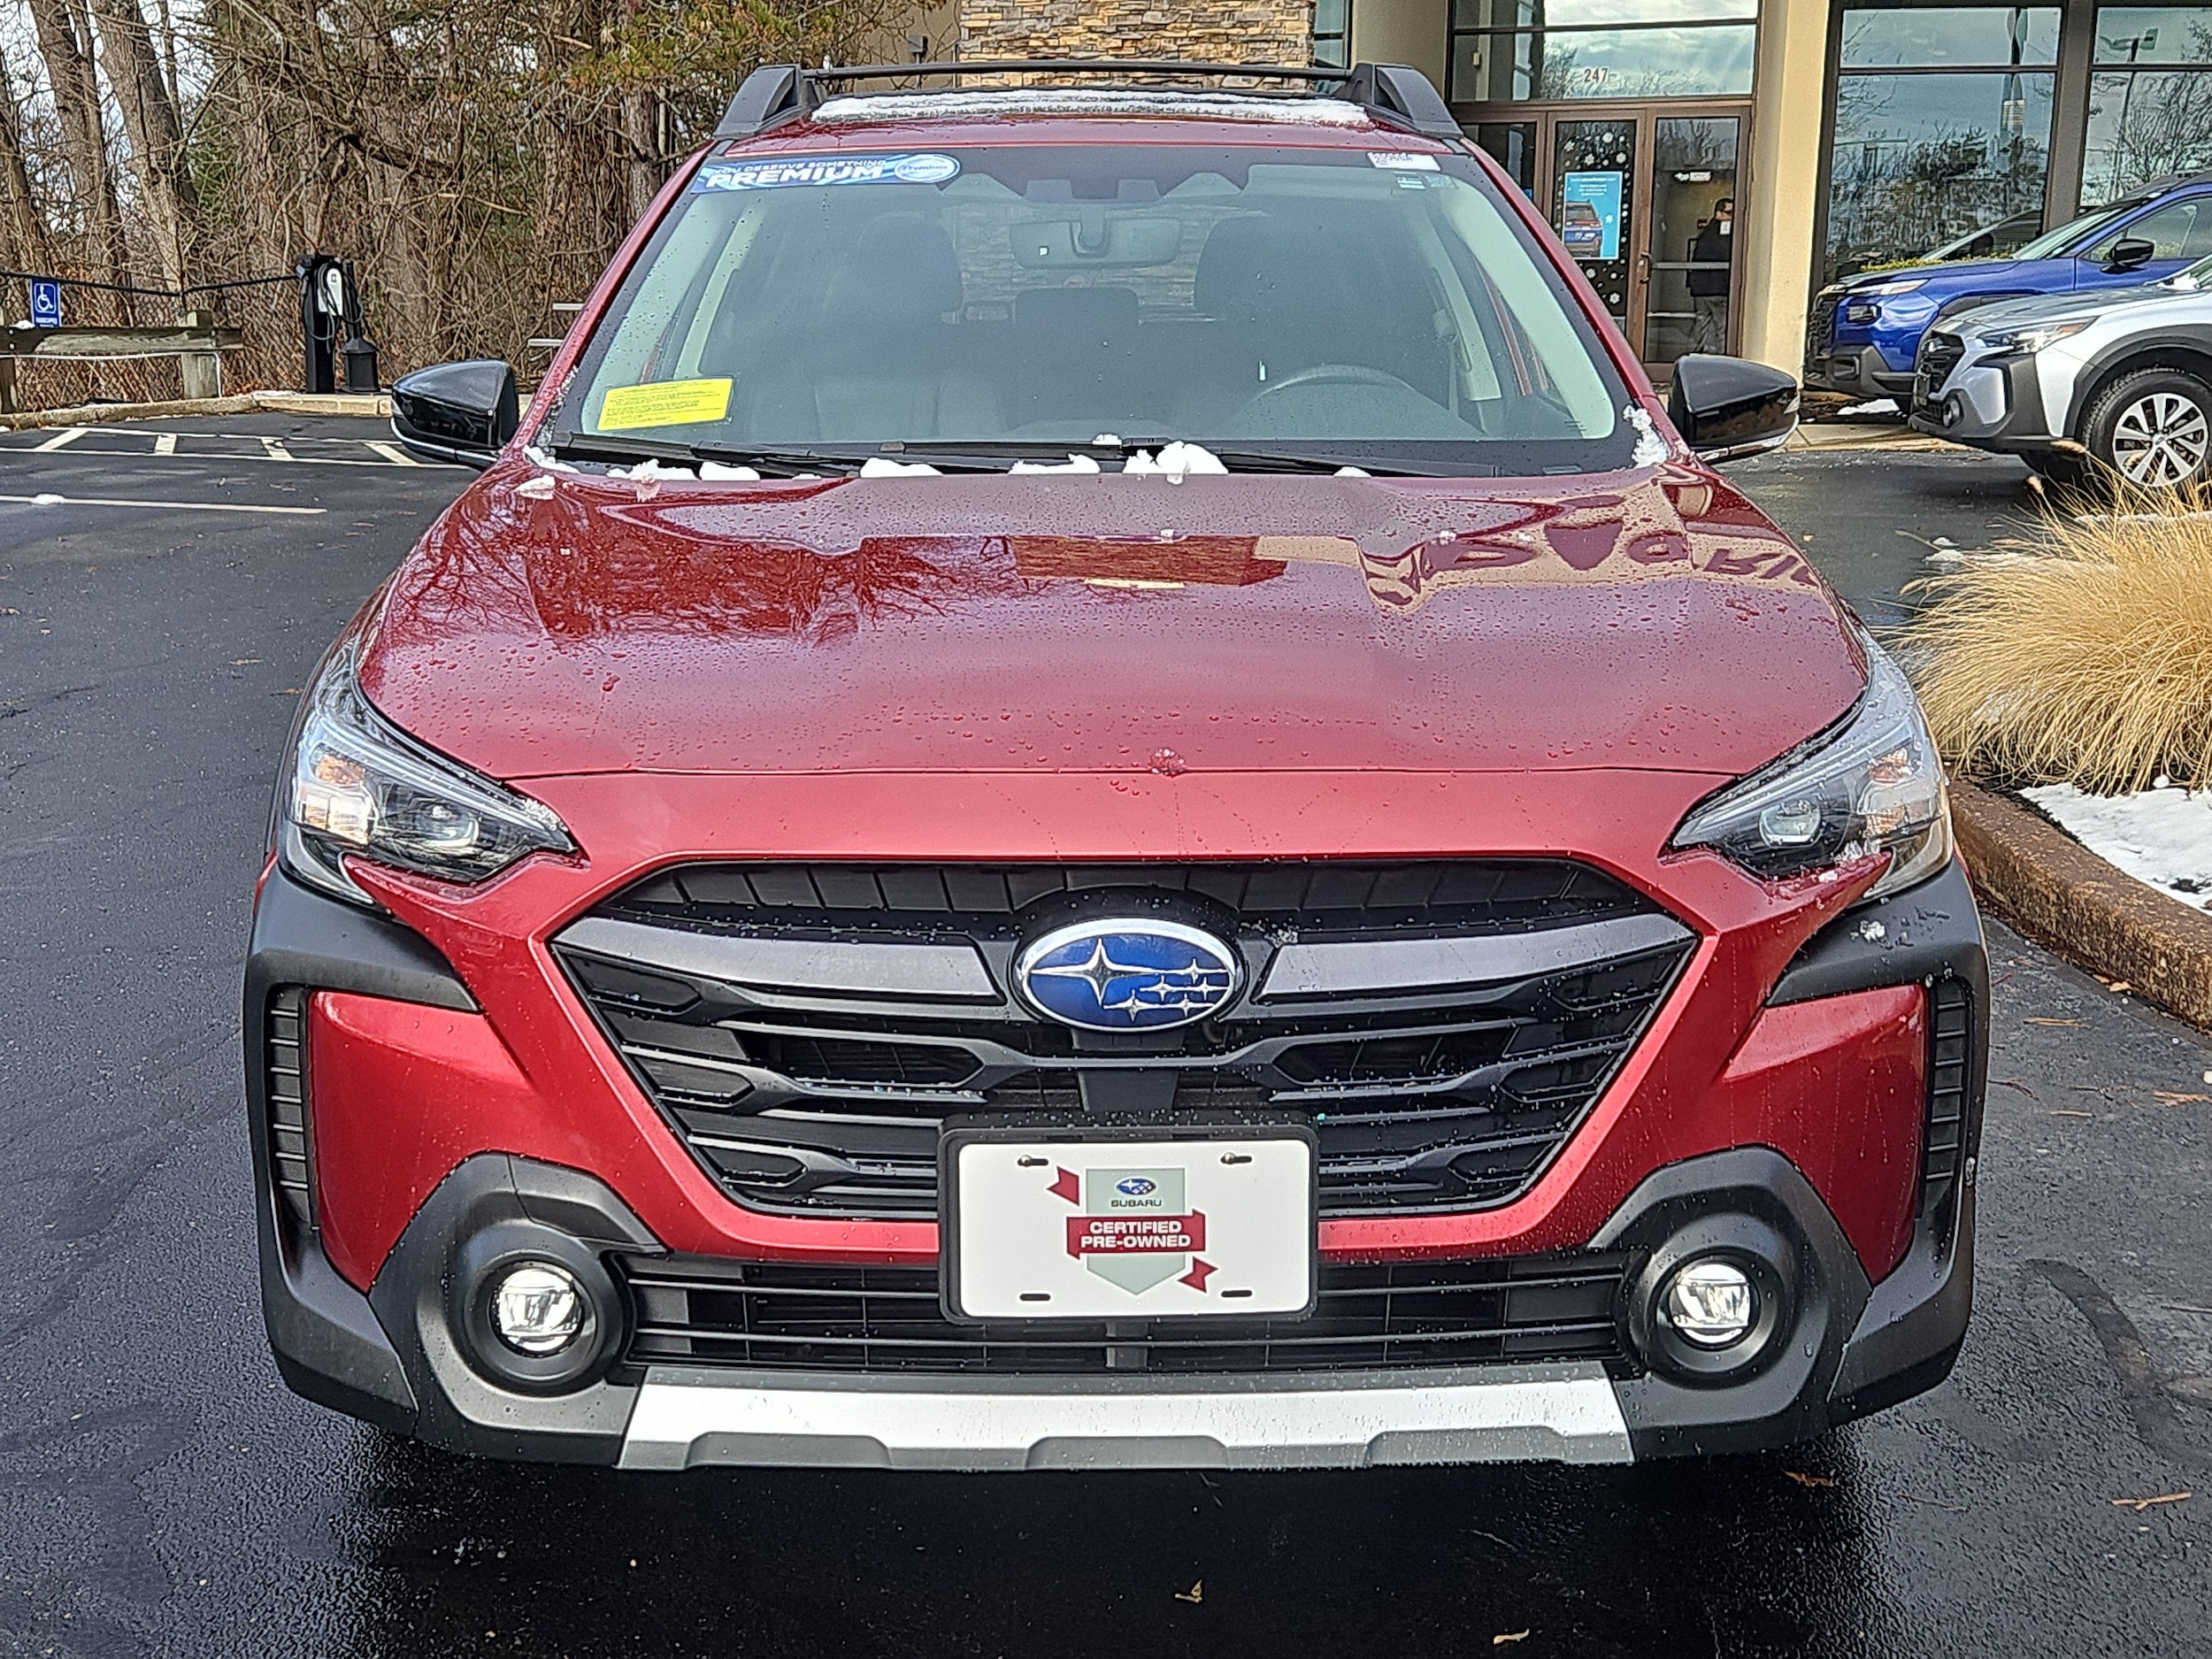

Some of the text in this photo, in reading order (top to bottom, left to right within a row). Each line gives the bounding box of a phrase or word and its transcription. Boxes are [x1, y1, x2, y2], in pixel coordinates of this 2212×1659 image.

[1584, 68, 1608, 83] 247
[744, 163, 806, 172] DESERVE
[808, 160, 887, 169] SOMETHING
[705, 165, 886, 188] PREMIUM
[1089, 1220, 1182, 1234] CERTIFIED
[1080, 1234, 1192, 1248] PRE-OWNED
